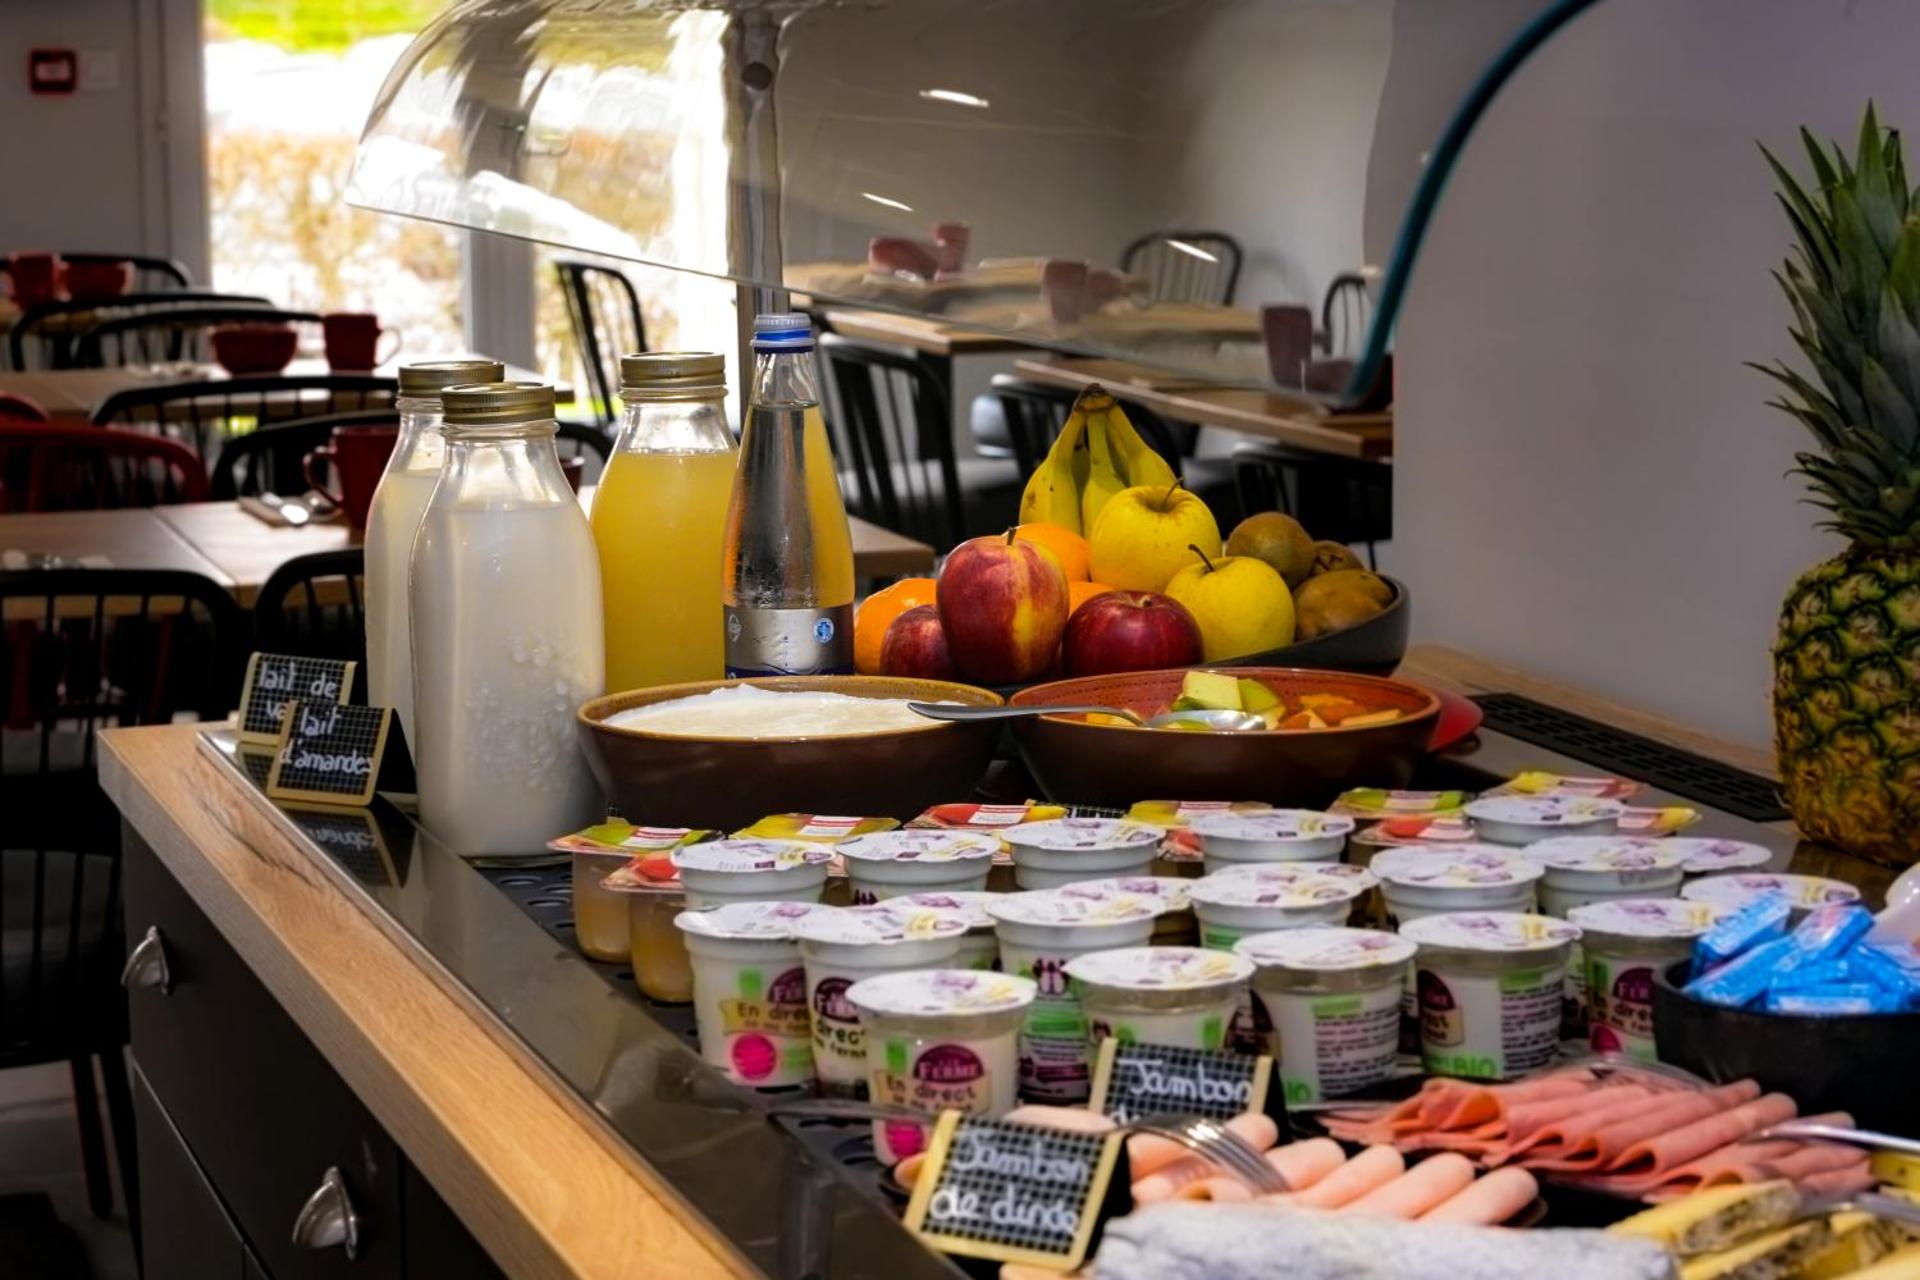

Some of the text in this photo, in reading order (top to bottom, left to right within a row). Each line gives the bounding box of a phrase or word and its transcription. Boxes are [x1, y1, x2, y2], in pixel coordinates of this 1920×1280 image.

[258, 661, 338, 699] lait de
[299, 705, 342, 736] lait
[278, 739, 374, 775] d'amandes
[1116, 1058, 1254, 1103] Jambon
[950, 1127, 1091, 1183] Jambon
[929, 1182, 1079, 1237] de dinde
